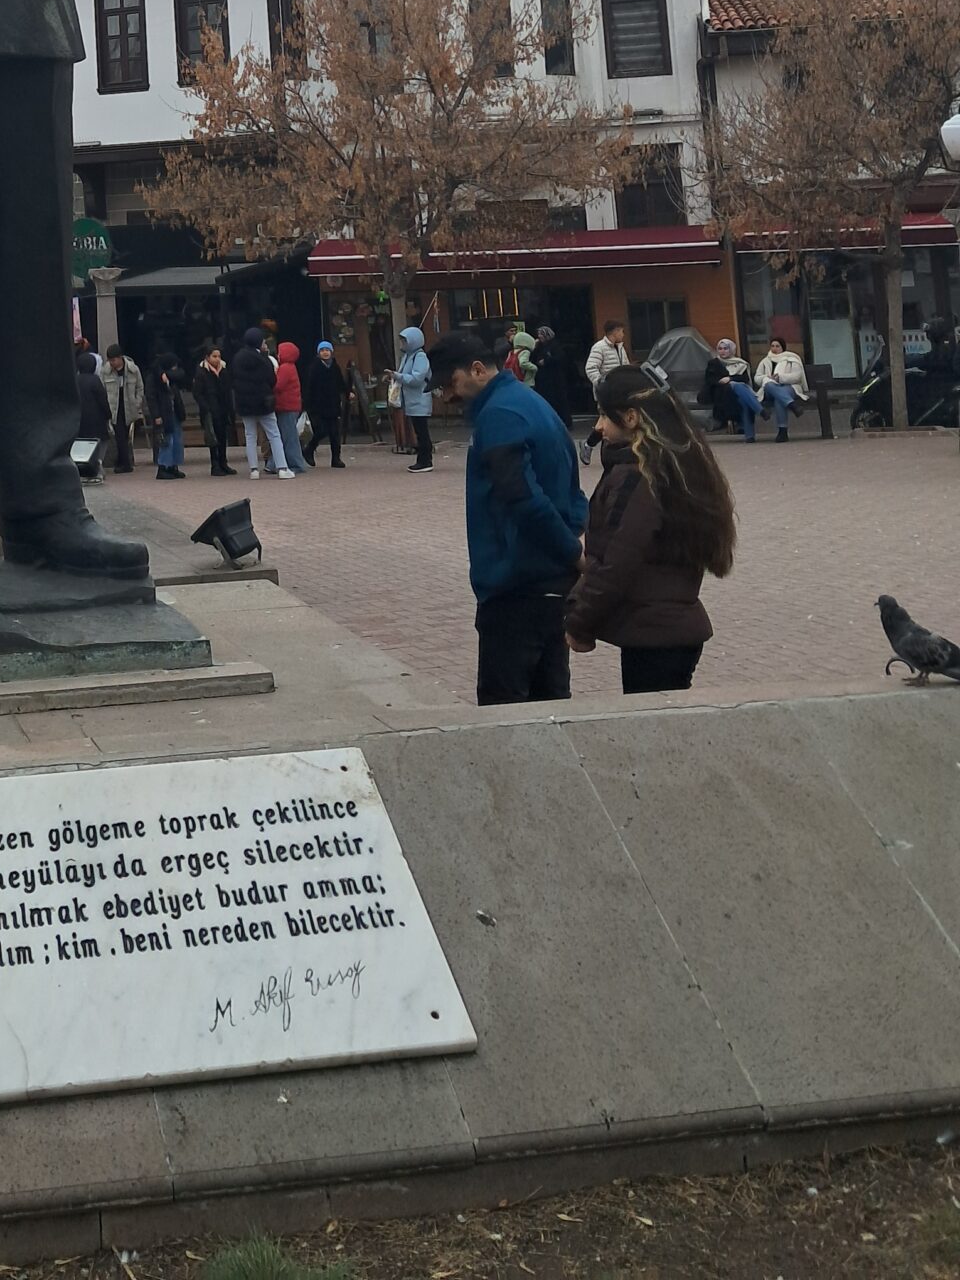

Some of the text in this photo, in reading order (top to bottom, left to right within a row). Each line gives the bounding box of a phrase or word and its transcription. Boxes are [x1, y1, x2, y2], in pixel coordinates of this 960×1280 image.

[47, 820, 147, 851] gölgeme
[158, 806, 240, 839] toprak
[252, 797, 359, 833] çekilince
[113, 853, 148, 880] da
[160, 851, 230, 878] ergeç
[243, 831, 374, 866] silecektir.
[102, 888, 206, 921] ebediyet
[215, 880, 289, 908] budur
[303, 873, 387, 900] amma;
[182, 917, 277, 948] nereden
[283, 902, 406, 937] bilecektir.
